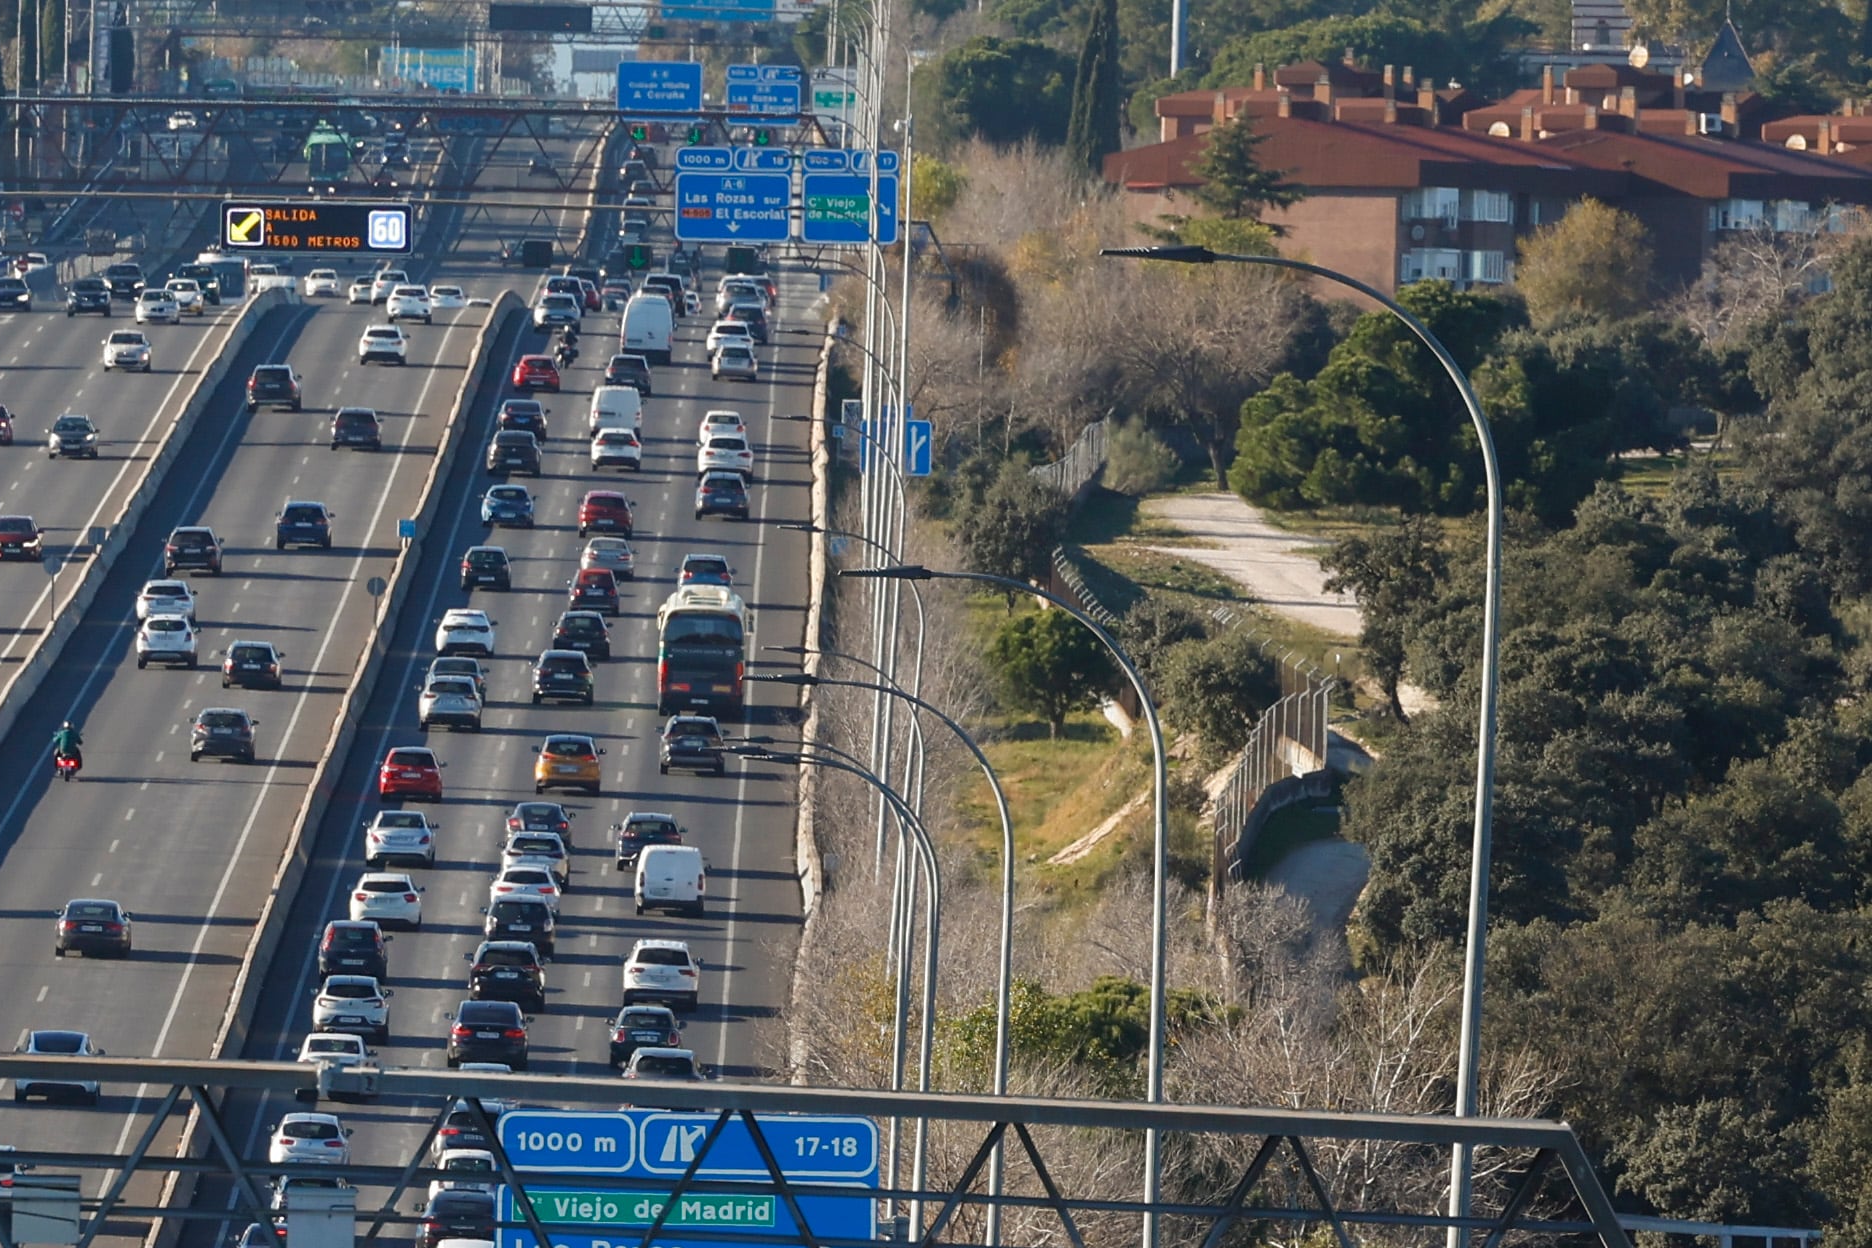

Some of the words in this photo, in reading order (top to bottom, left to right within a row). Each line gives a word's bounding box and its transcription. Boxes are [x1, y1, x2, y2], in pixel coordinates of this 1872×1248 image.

[683, 155, 710, 164] 1000
[883, 157, 892, 165] 17
[724, 179, 743, 190] A-6
[685, 192, 708, 203] Las
[716, 192, 755, 204] Rozas
[763, 196, 781, 204] sur
[826, 198, 856, 209] Viejo
[265, 209, 316, 221] SALIDA
[715, 207, 730, 219] El
[734, 208, 786, 220] Escorial
[808, 210, 822, 219] de
[265, 223, 272, 232] A
[373, 217, 401, 242] 60
[266, 236, 299, 247] 1500
[308, 236, 360, 247] METROS
[517, 1132, 582, 1152] 1000
[594, 1136, 617, 1152] m
[795, 1137, 858, 1157] 17-18
[554, 1197, 618, 1221] Viejo
[633, 1198, 662, 1219] de
[681, 1201, 770, 1221] Madrid
